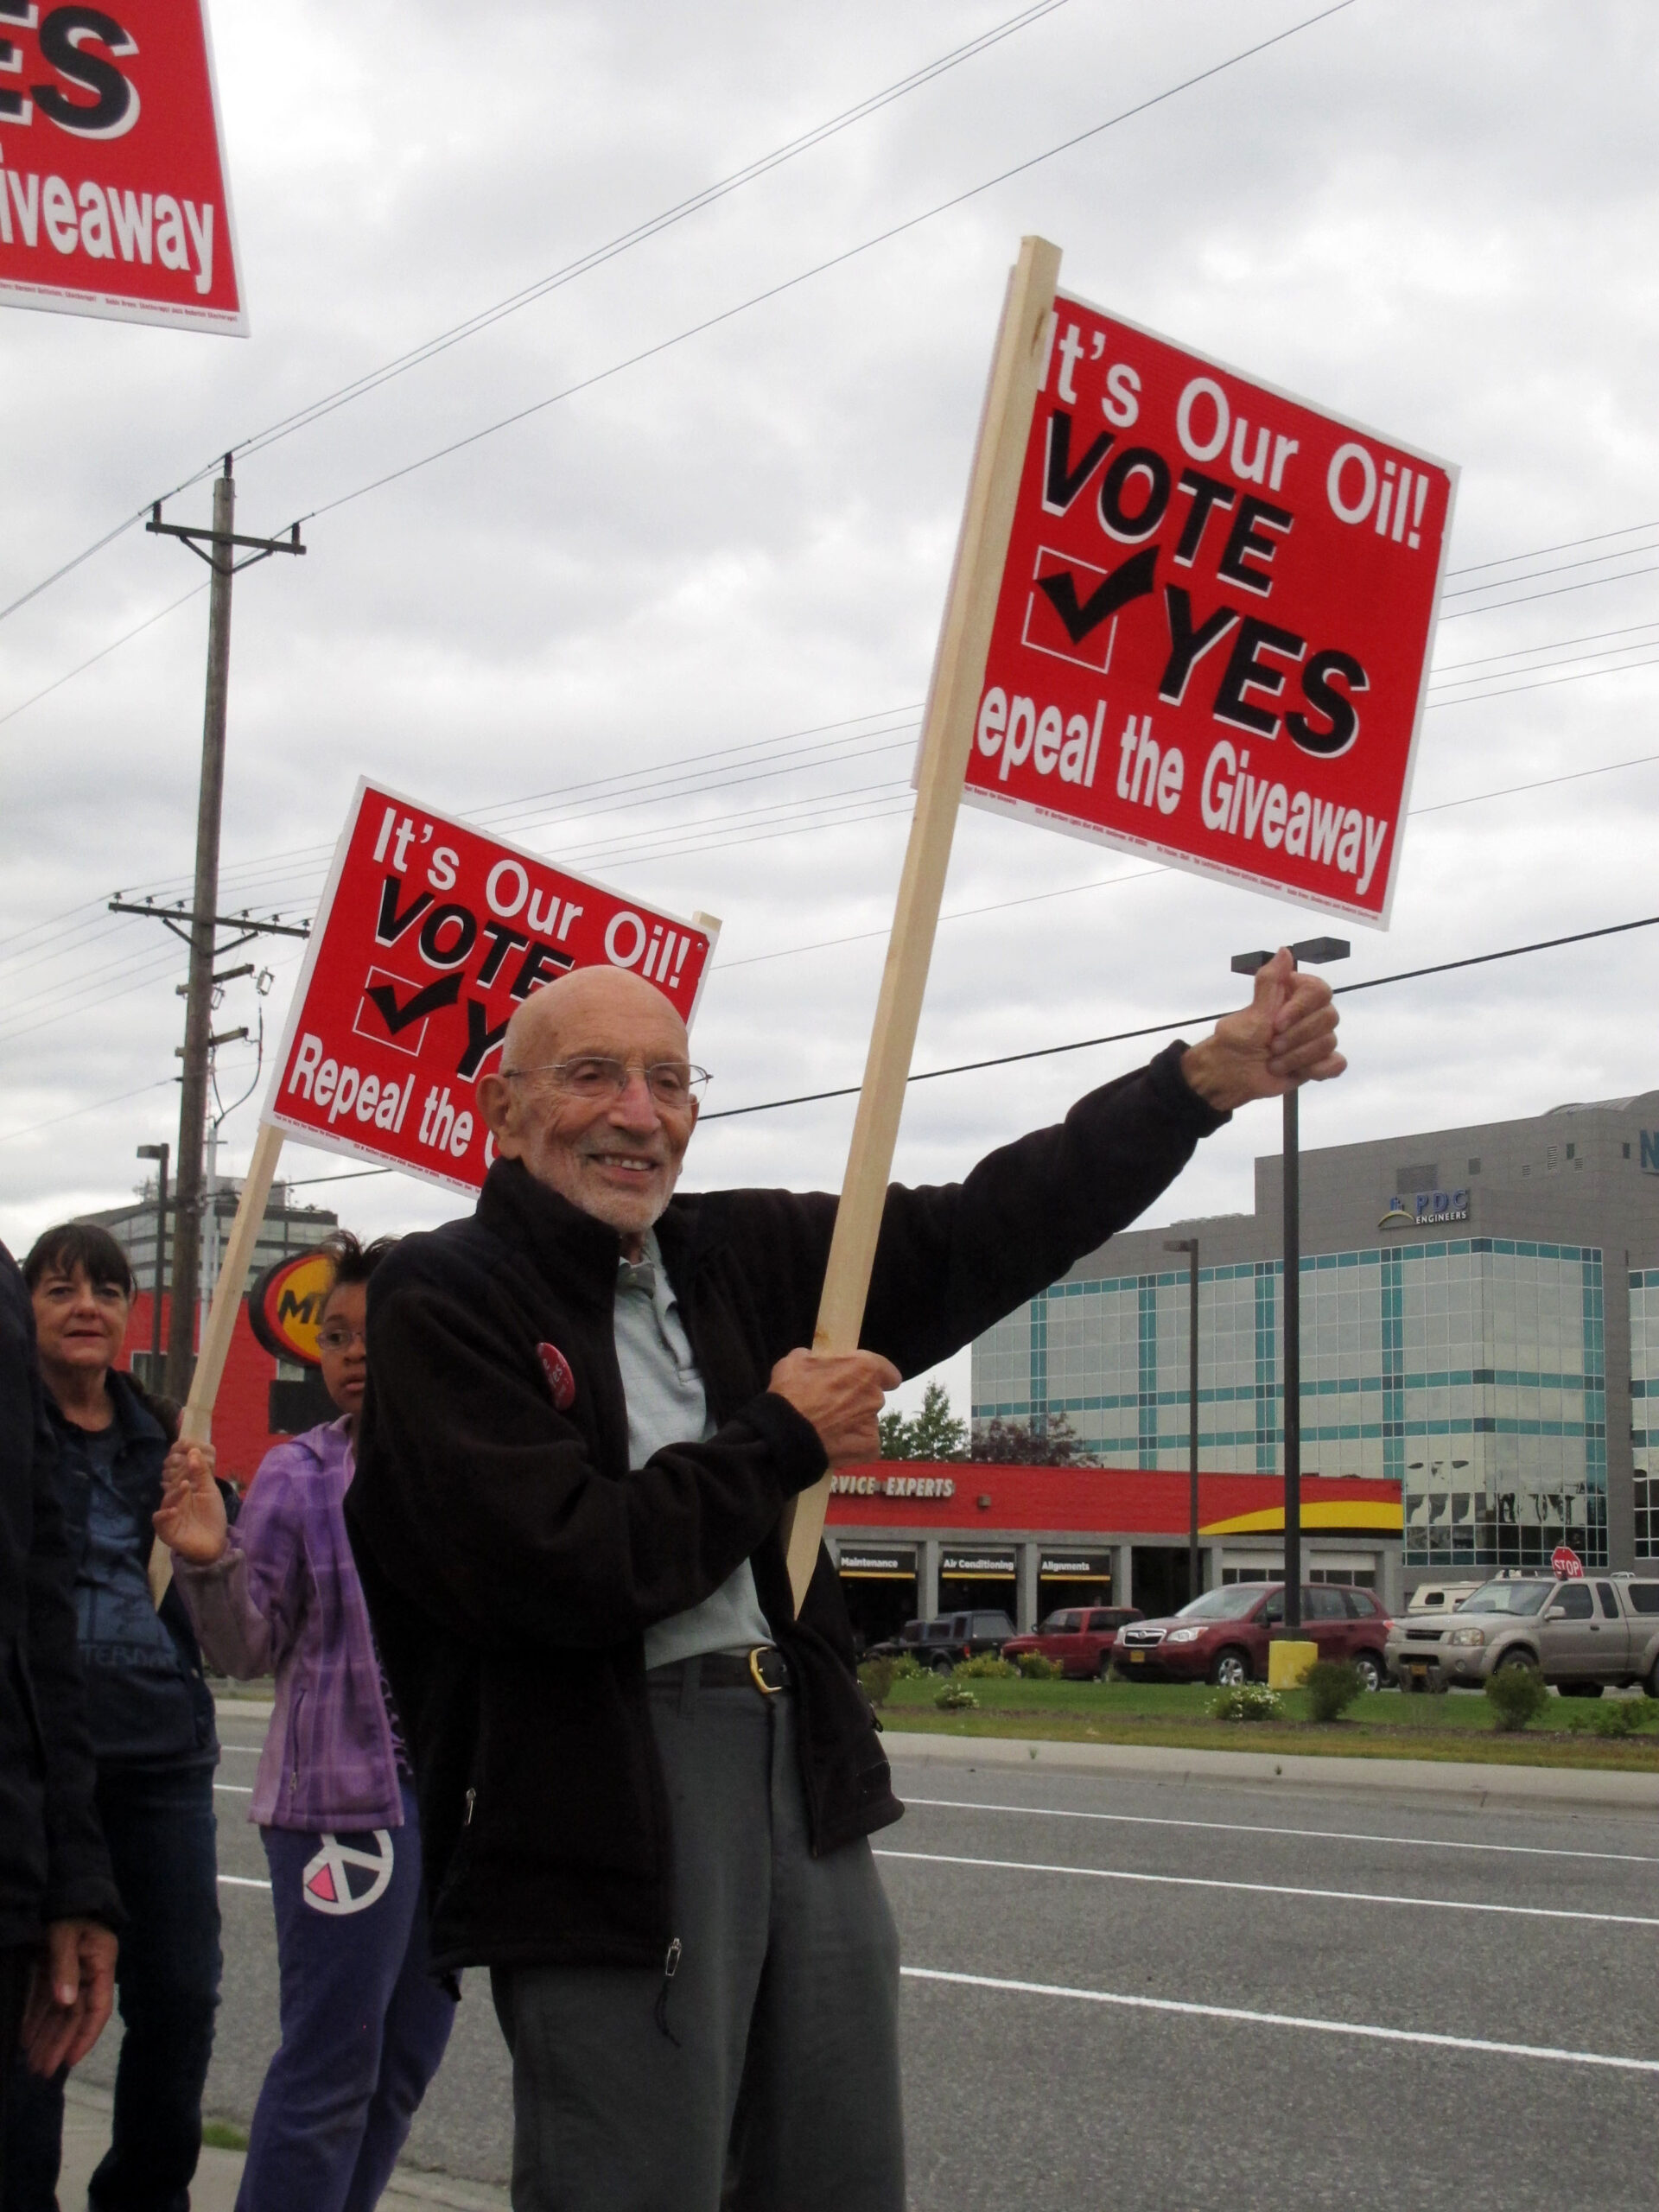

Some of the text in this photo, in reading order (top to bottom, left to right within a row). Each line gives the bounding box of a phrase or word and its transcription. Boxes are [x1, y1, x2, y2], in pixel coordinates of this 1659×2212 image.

[0, 143, 213, 295] iveaway
[1037, 311, 1429, 550] It's Our Oil!
[1039, 409, 1293, 598] VOTE
[1158, 583, 1370, 758] YES
[978, 687, 1107, 788] epeal
[1117, 714, 1184, 815] the
[1200, 740, 1388, 894] Giveaway
[372, 808, 690, 989] It's Our Oil!
[375, 874, 576, 1001] VOTE
[289, 1033, 416, 1133] Repeal
[418, 1087, 473, 1158] the
[1416, 1211, 1466, 1224] ENGINEERS
[1417, 1188, 1467, 1216] PDC
[830, 1476, 954, 1497] RVICE EXPERTS
[841, 1557, 899, 1568] Maintenance
[944, 1559, 1014, 1571] Air Conditioning
[1042, 1561, 1090, 1572] Alignments
[1554, 1560, 1580, 1576] STOP
